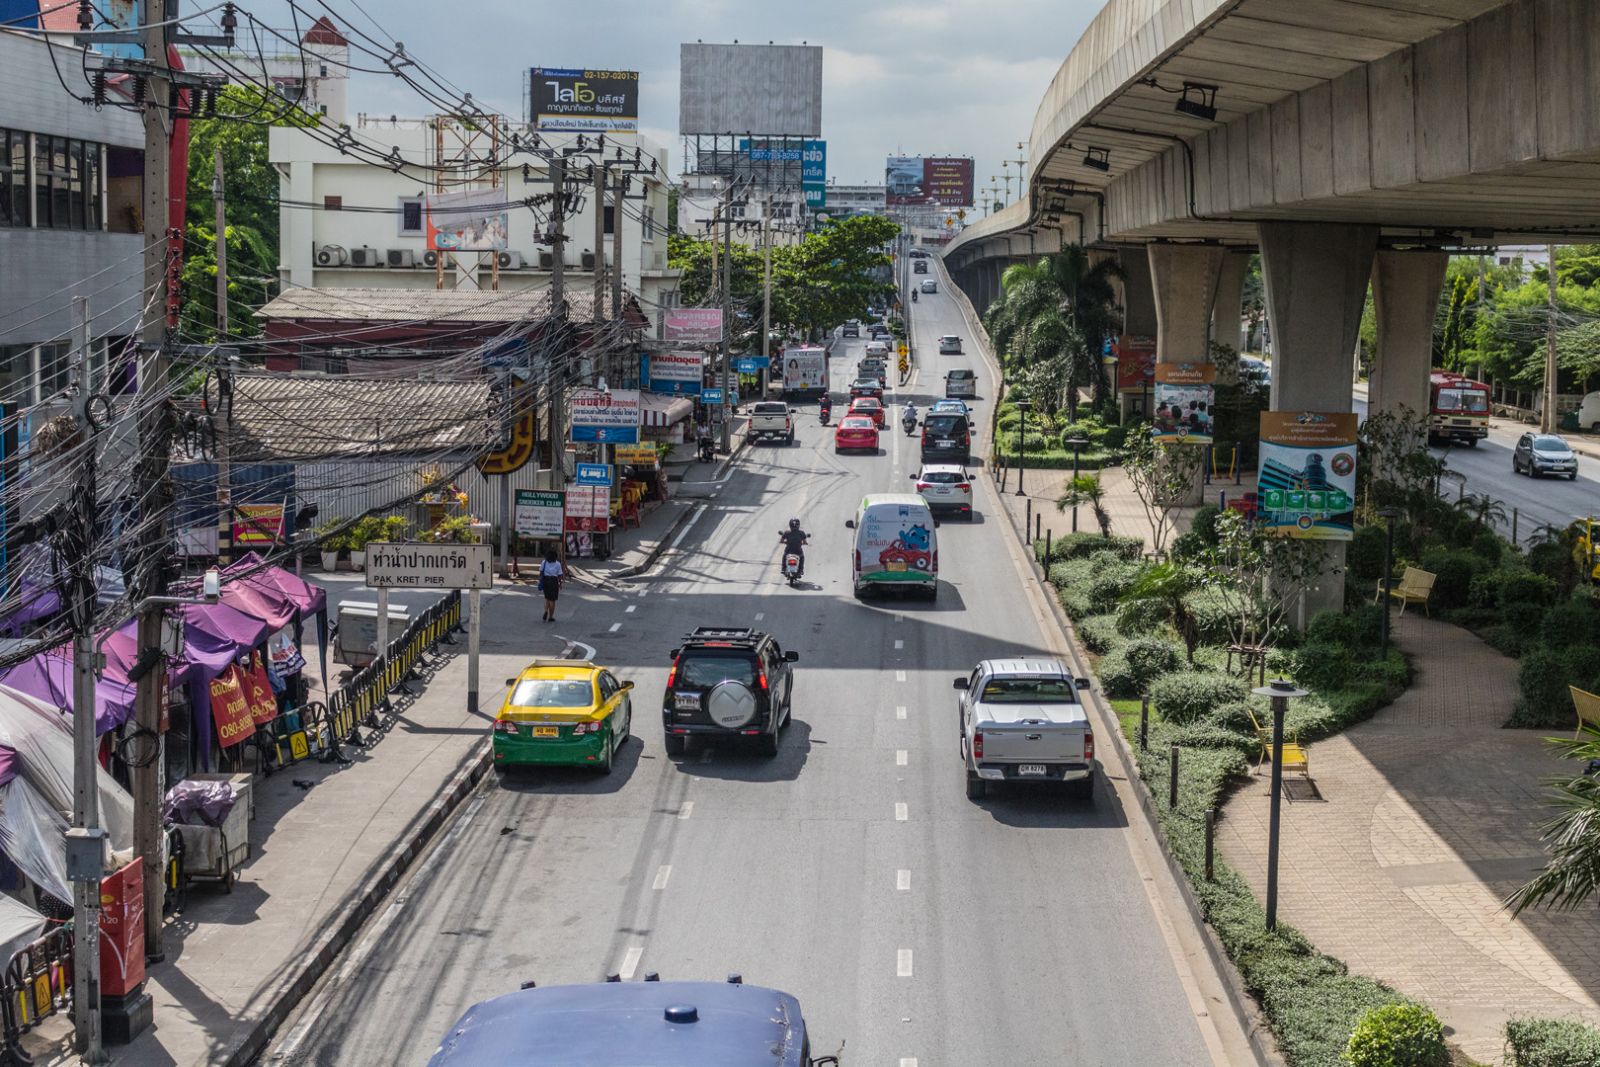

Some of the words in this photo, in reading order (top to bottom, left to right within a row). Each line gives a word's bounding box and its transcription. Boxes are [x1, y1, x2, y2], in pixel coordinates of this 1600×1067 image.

[545, 81, 595, 103] ไลโอ
[373, 548, 466, 569] ท่าน้ำปากเกร็ด
[479, 561, 485, 574] 1
[374, 575, 392, 583] PAK
[396, 576, 420, 584] KRET
[424, 576, 445, 584] PIER
